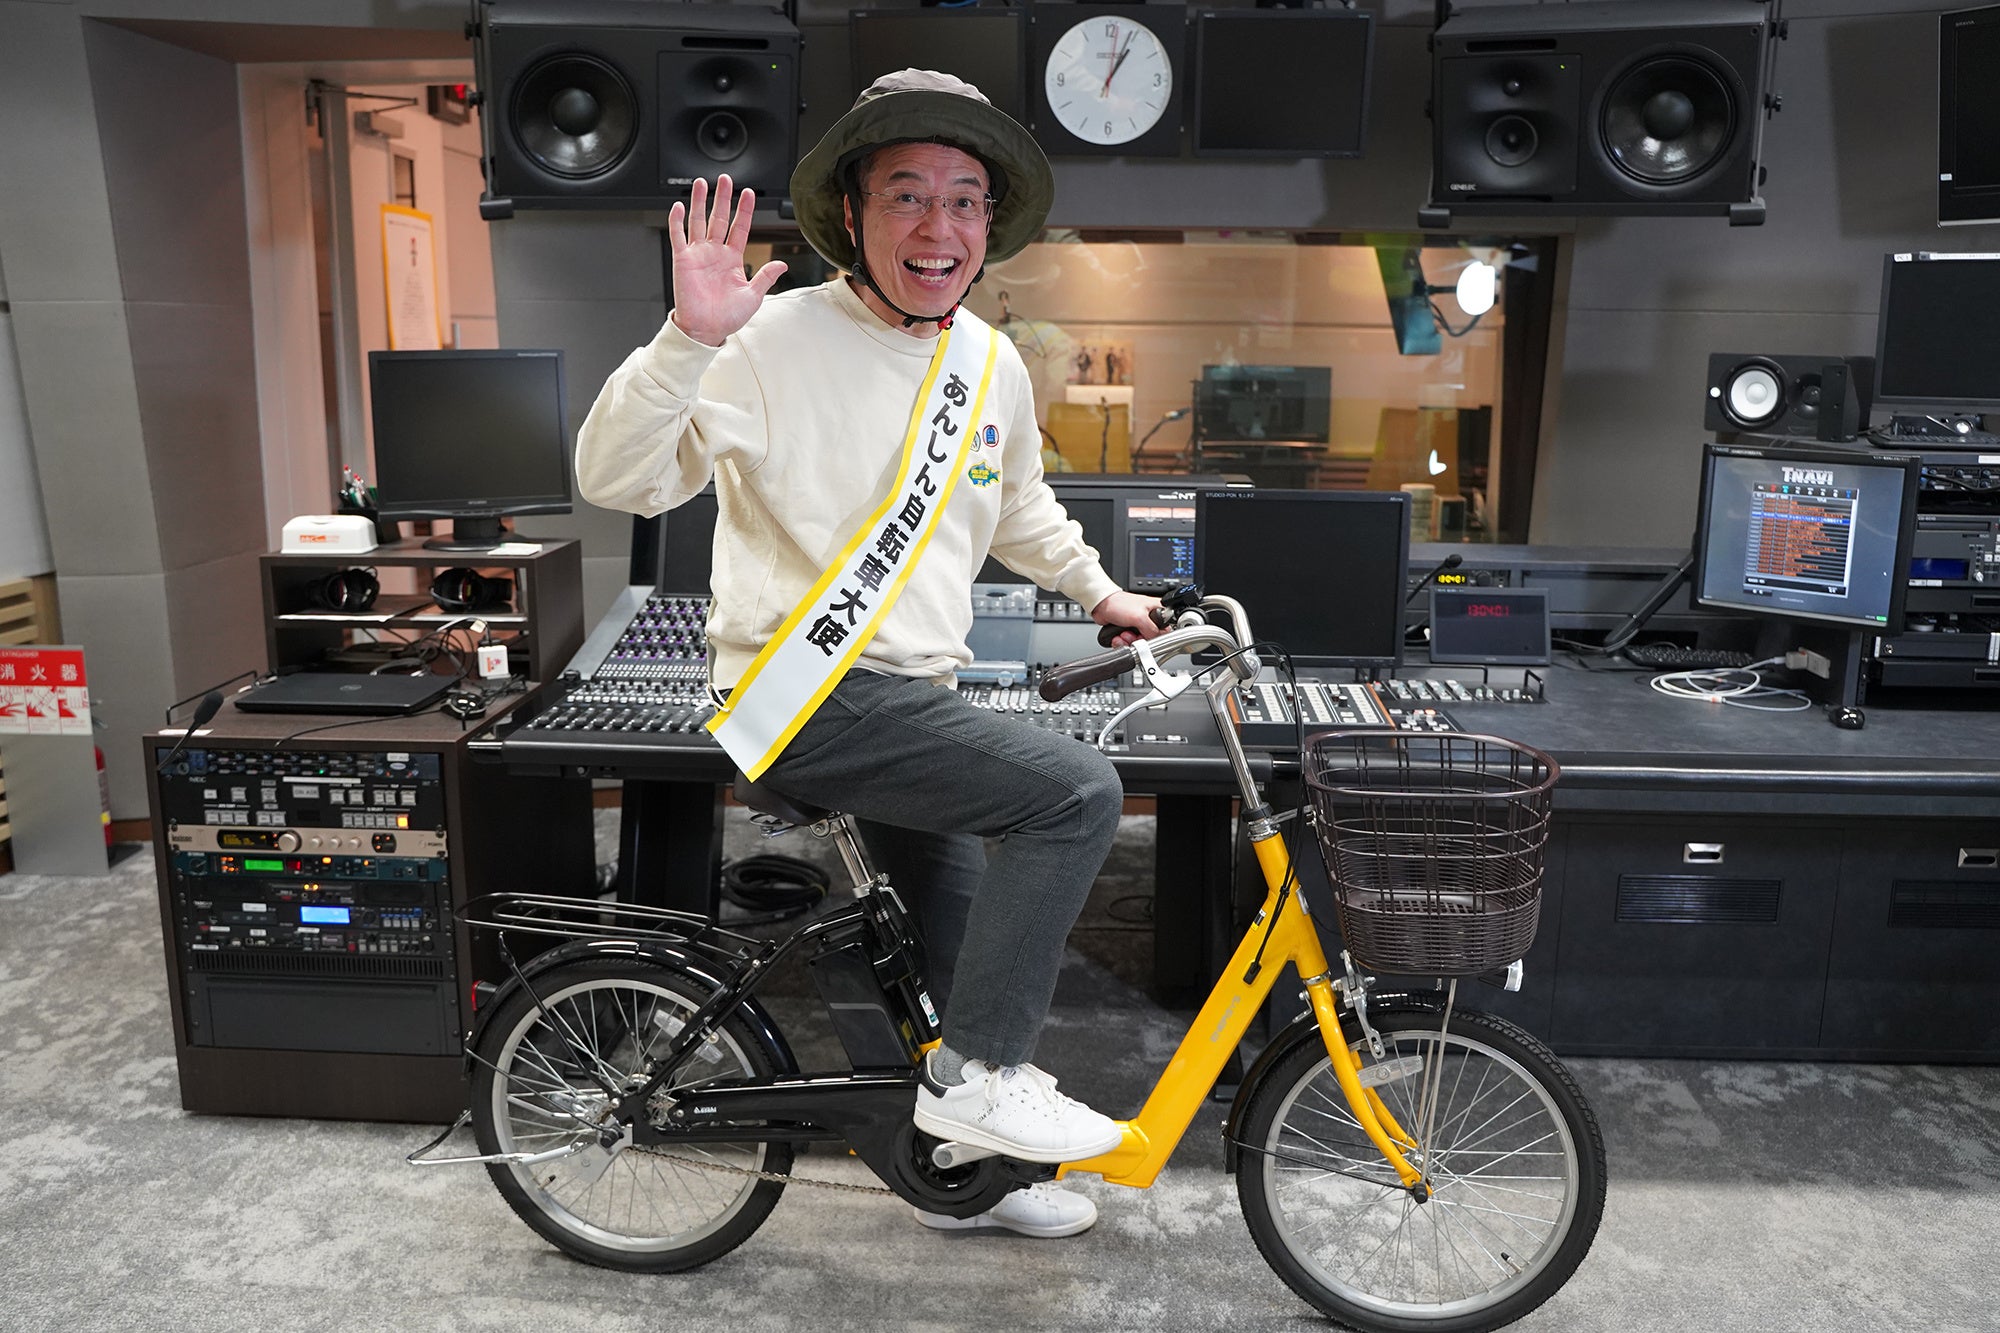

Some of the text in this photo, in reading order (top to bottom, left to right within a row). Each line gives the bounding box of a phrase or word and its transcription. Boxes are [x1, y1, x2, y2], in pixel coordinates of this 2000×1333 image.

[1105, 23, 1117, 38] 12
[1057, 72, 1065, 87] 9
[1153, 73, 1162, 88] 3
[1104, 121, 1112, 136] 6
[805, 372, 970, 657] あんしん自転車大使
[0, 663, 78, 682] 消火器
